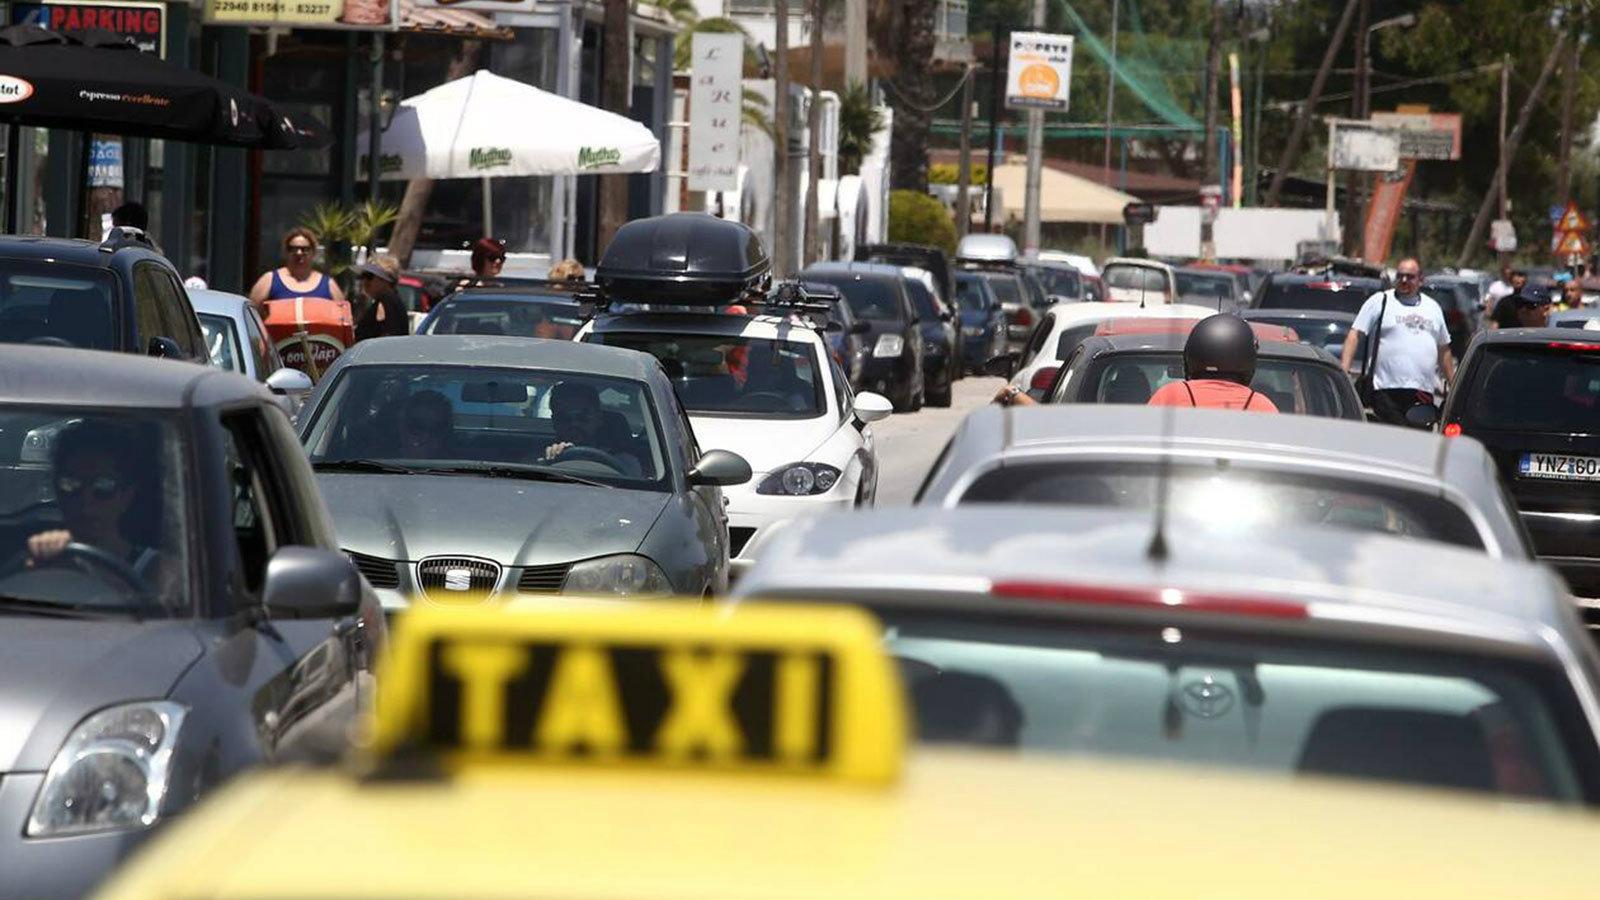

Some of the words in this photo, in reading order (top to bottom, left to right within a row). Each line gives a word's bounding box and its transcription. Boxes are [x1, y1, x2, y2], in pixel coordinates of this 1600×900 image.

[51, 7, 159, 34] PARKING
[79, 90, 121, 101] espresso
[1576, 458, 1600, 475] 60
[440, 643, 818, 760] TAXI
